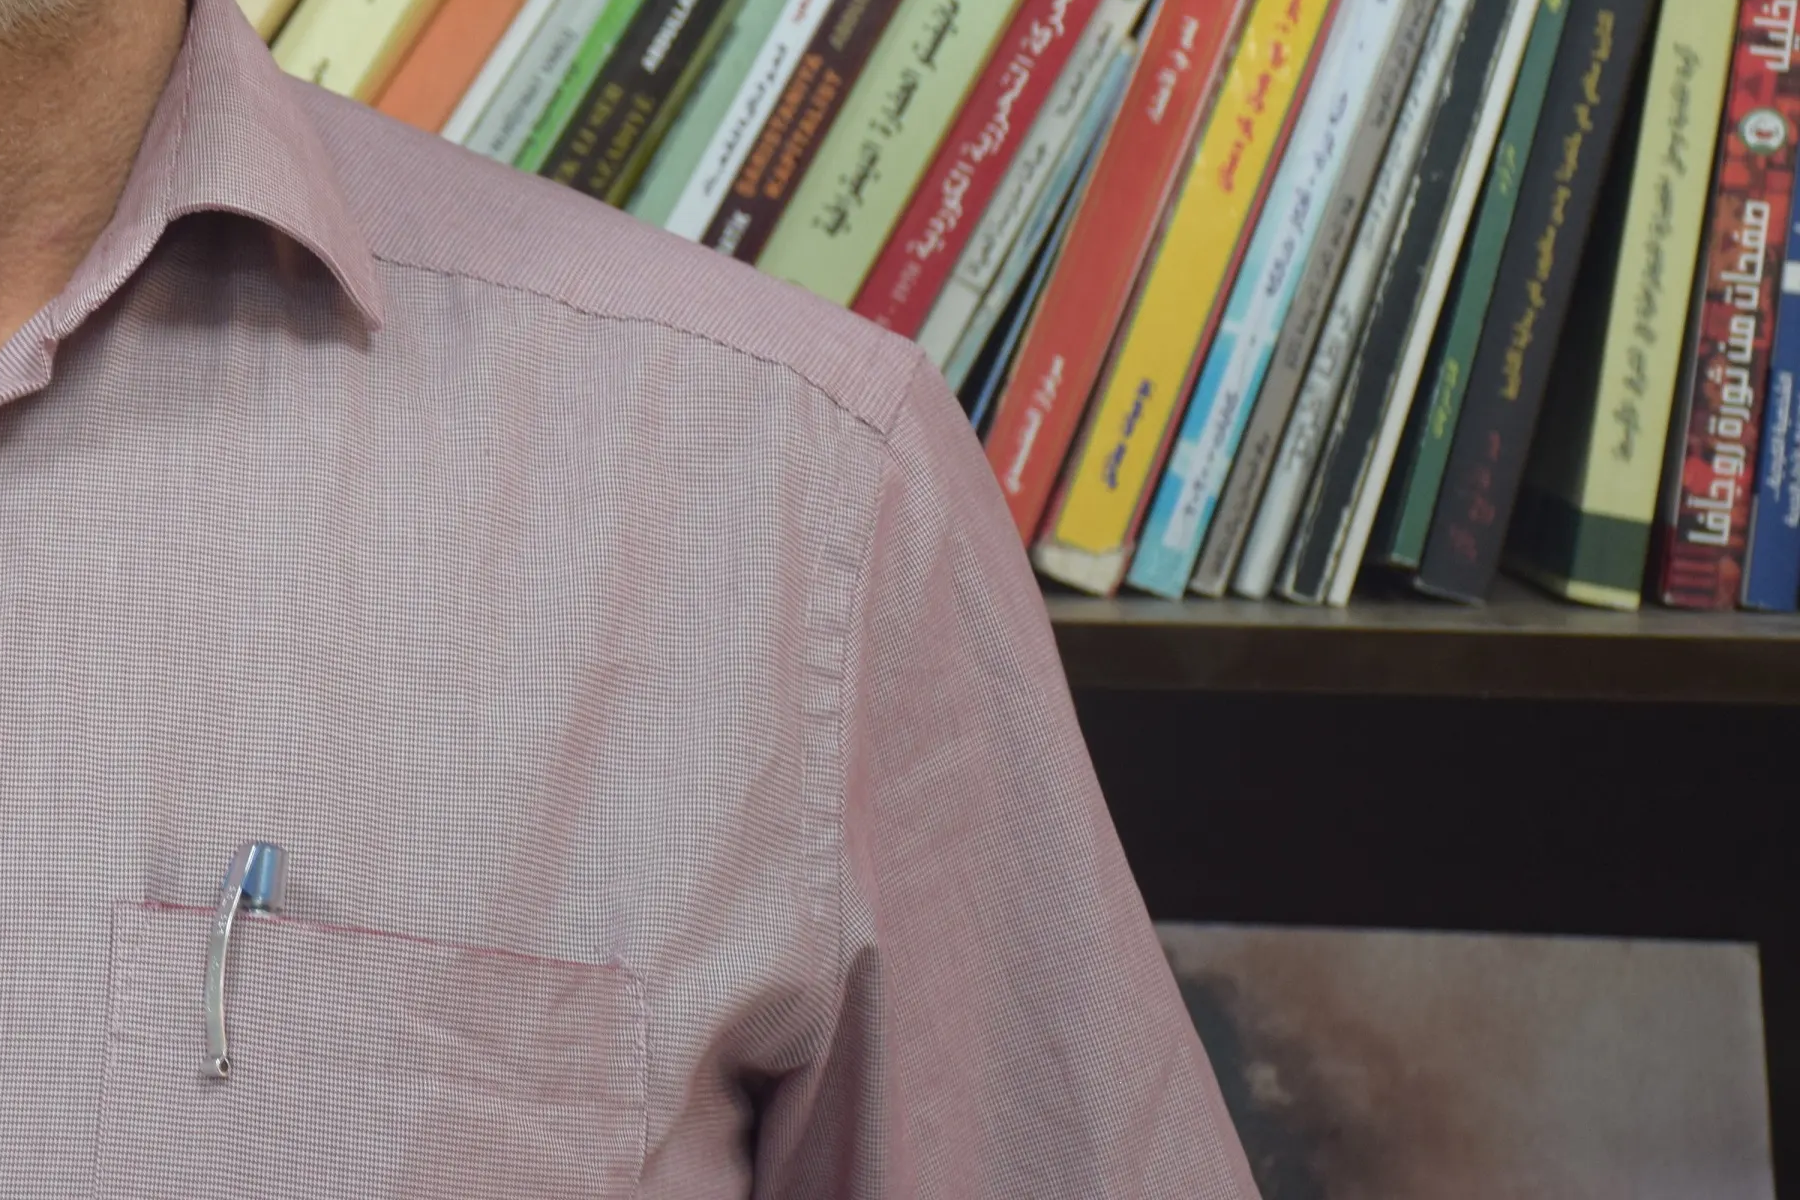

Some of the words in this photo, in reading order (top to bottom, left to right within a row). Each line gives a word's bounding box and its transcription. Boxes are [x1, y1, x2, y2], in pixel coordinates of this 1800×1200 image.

[957, 50, 1046, 168] التحررية
[903, 157, 984, 266] الكوردية
[1718, 198, 1772, 308] صفحات
[1716, 313, 1757, 362] من
[1698, 363, 1755, 440] ثورة
